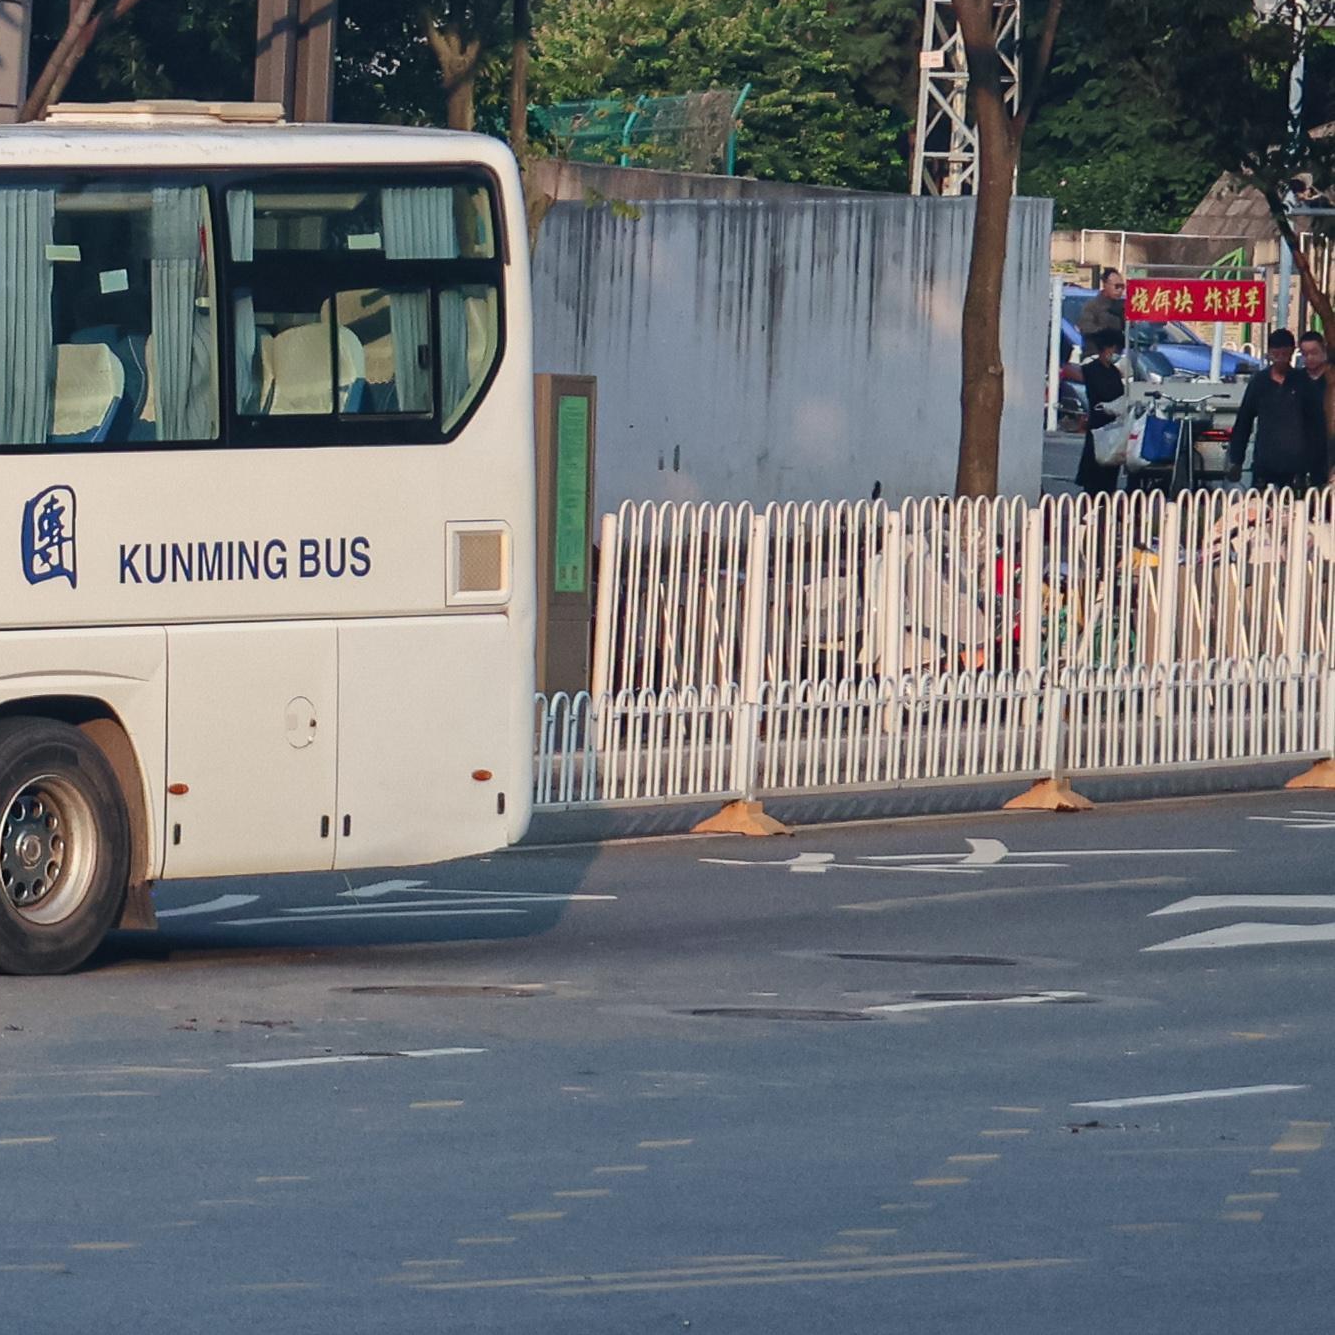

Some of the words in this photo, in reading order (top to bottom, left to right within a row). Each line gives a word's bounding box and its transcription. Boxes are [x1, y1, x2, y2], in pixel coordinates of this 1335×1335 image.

[1131, 286, 1194, 315] 烧饵块
[1204, 286, 1260, 316] 炸洋芋
[119, 538, 287, 584] KUNMING
[299, 536, 371, 578] BUS
